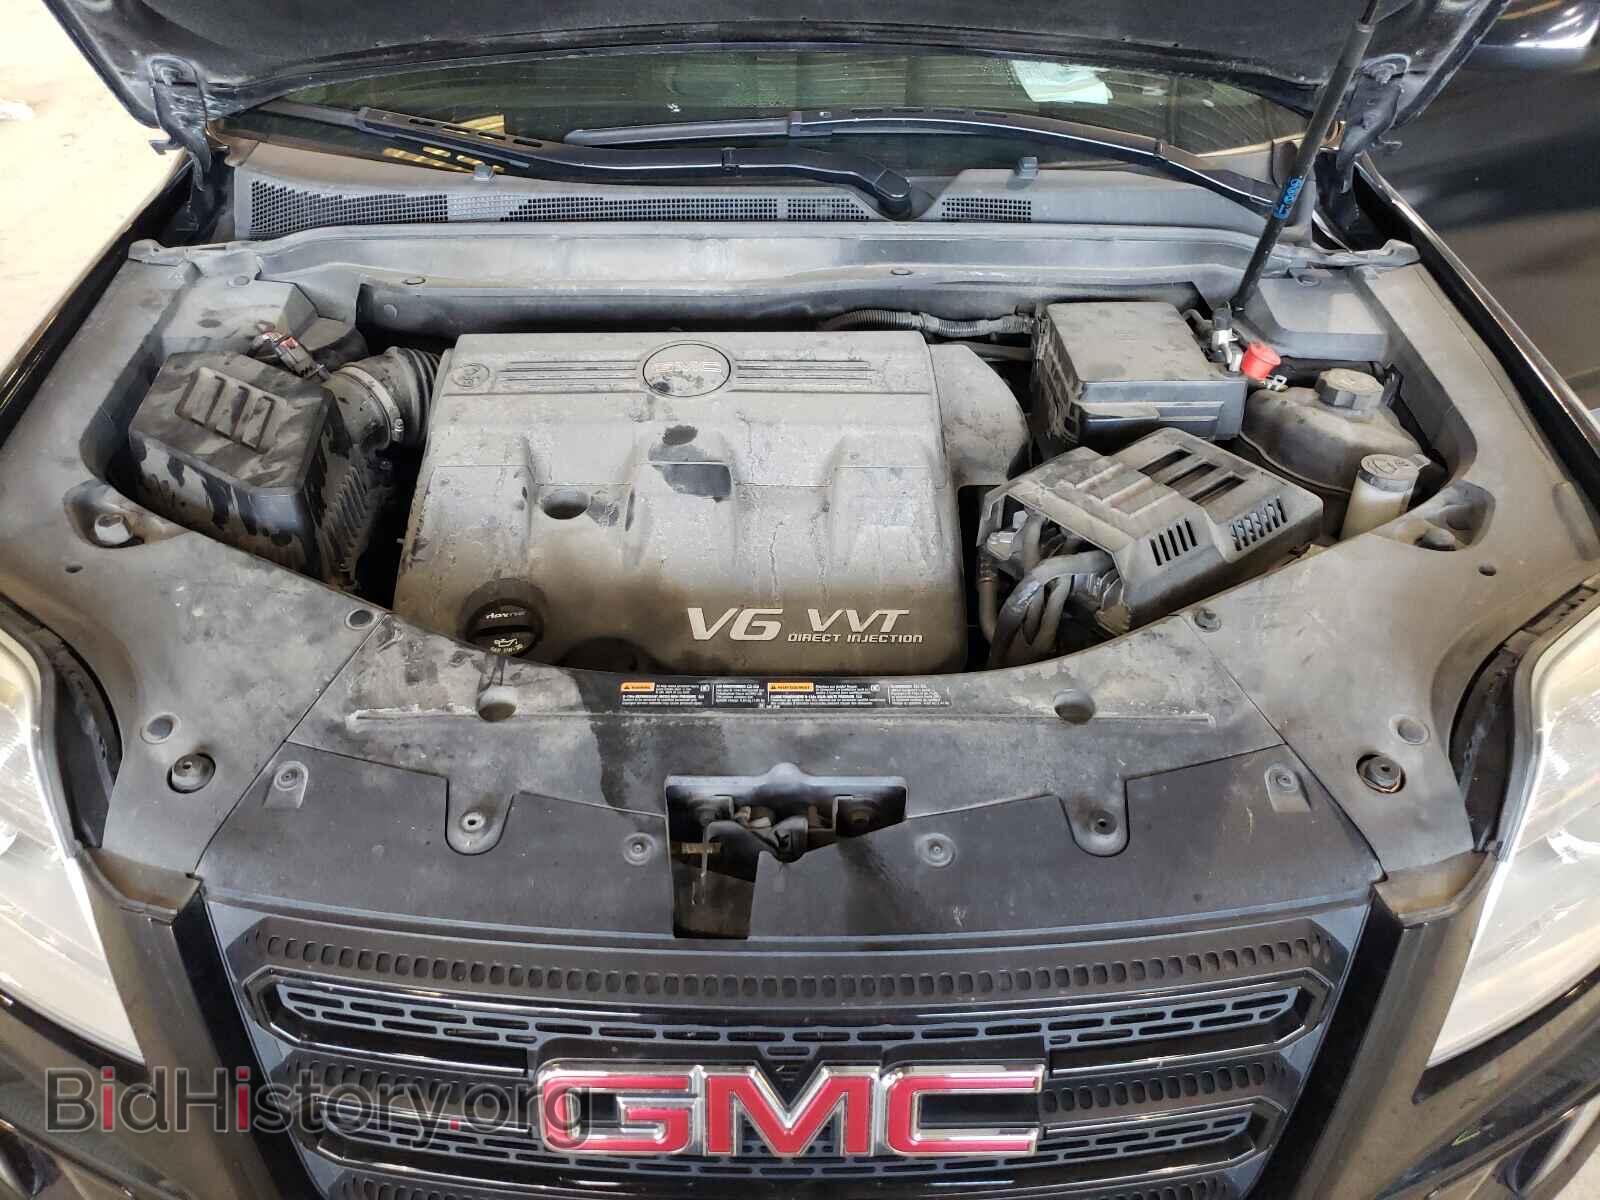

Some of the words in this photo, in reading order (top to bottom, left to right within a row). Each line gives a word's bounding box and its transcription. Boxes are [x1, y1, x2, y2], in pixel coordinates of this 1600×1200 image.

[687, 607, 784, 641] V6
[807, 608, 910, 633] VVT
[787, 633, 842, 643] DIRECT
[847, 633, 924, 644] INJECTION
[536, 1061, 1046, 1155] GMC
